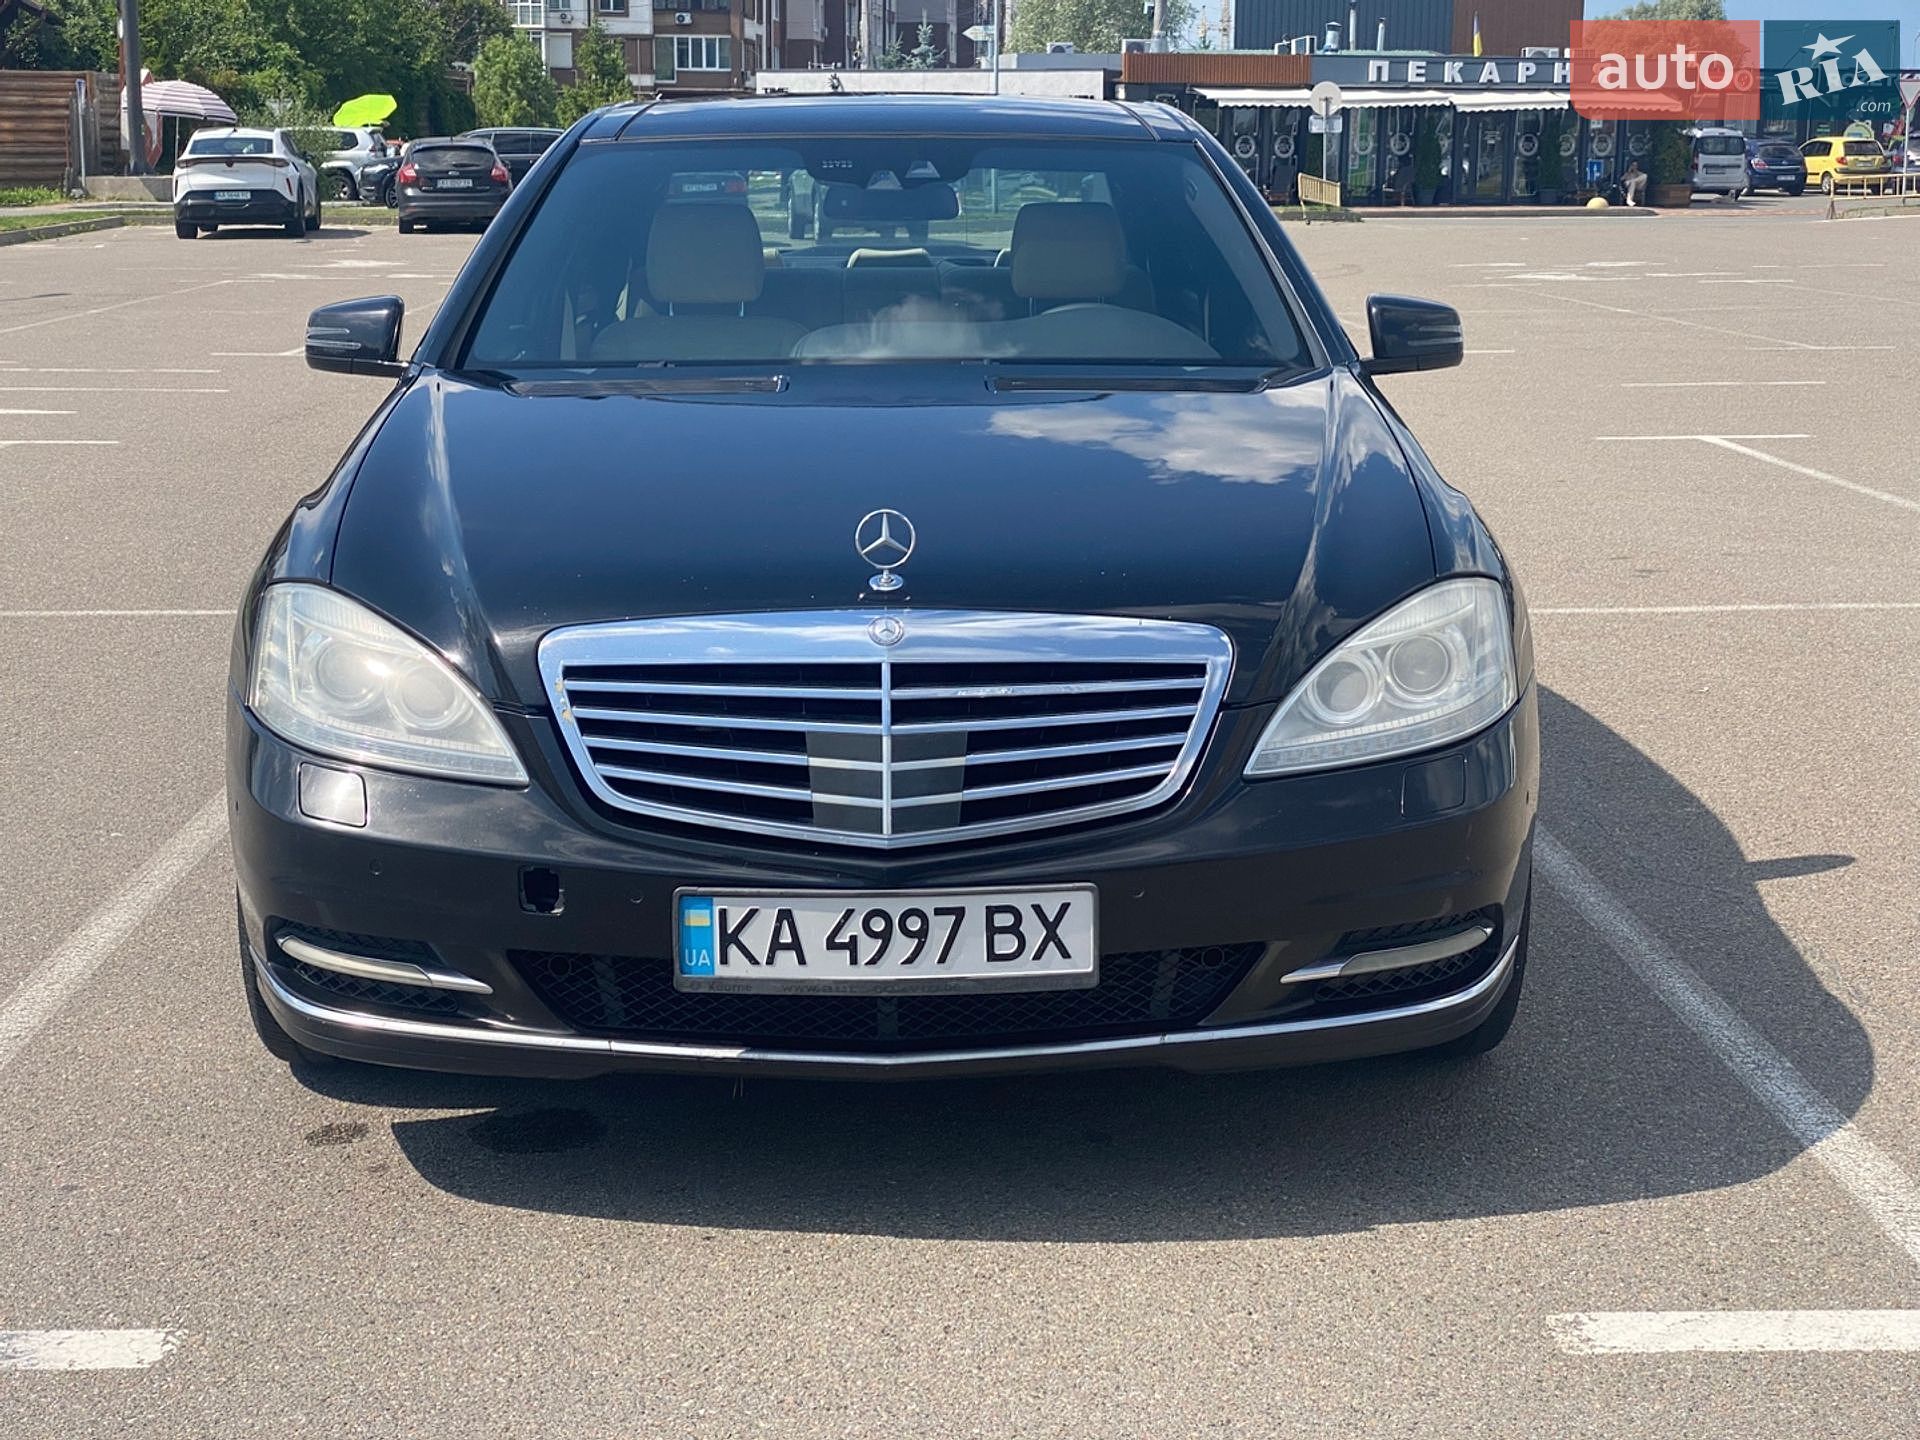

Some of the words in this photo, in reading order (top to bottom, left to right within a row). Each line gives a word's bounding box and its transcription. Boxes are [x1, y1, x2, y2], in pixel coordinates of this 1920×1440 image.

[718, 907, 806, 966] KA
[825, 907, 966, 966] 4997
[985, 902, 1072, 962] BX
[685, 949, 711, 967] UA
